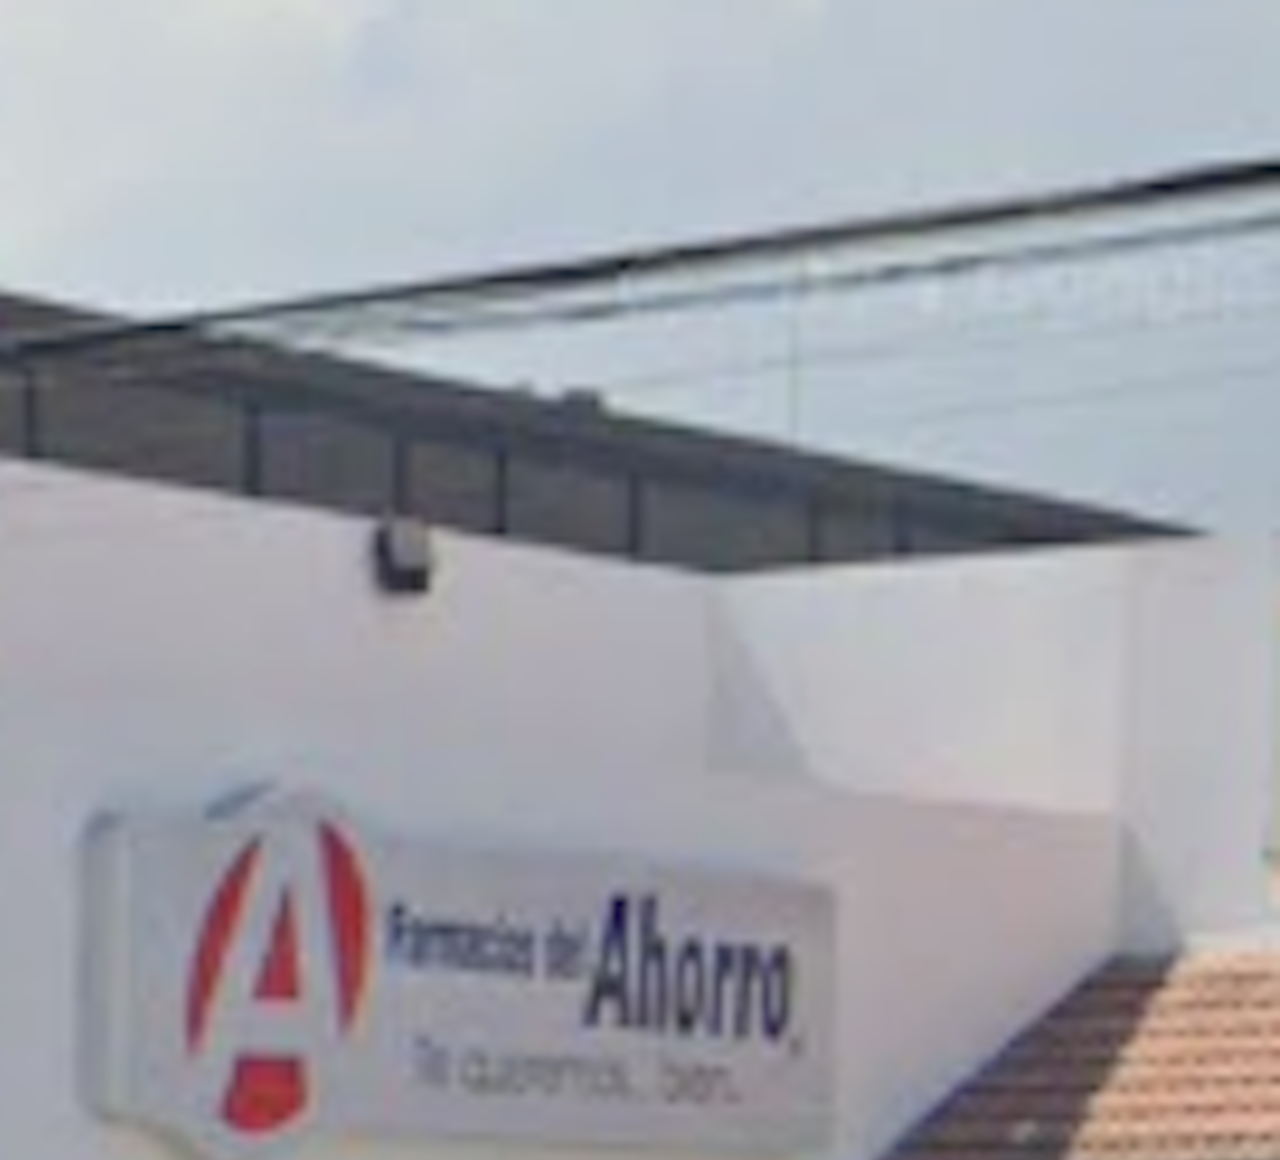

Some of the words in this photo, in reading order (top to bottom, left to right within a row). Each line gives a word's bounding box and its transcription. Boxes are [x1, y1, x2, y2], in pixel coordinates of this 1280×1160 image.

[386, 900, 537, 980] Farmacias
[544, 914, 588, 981] del
[582, 894, 792, 1042] Ahorro
